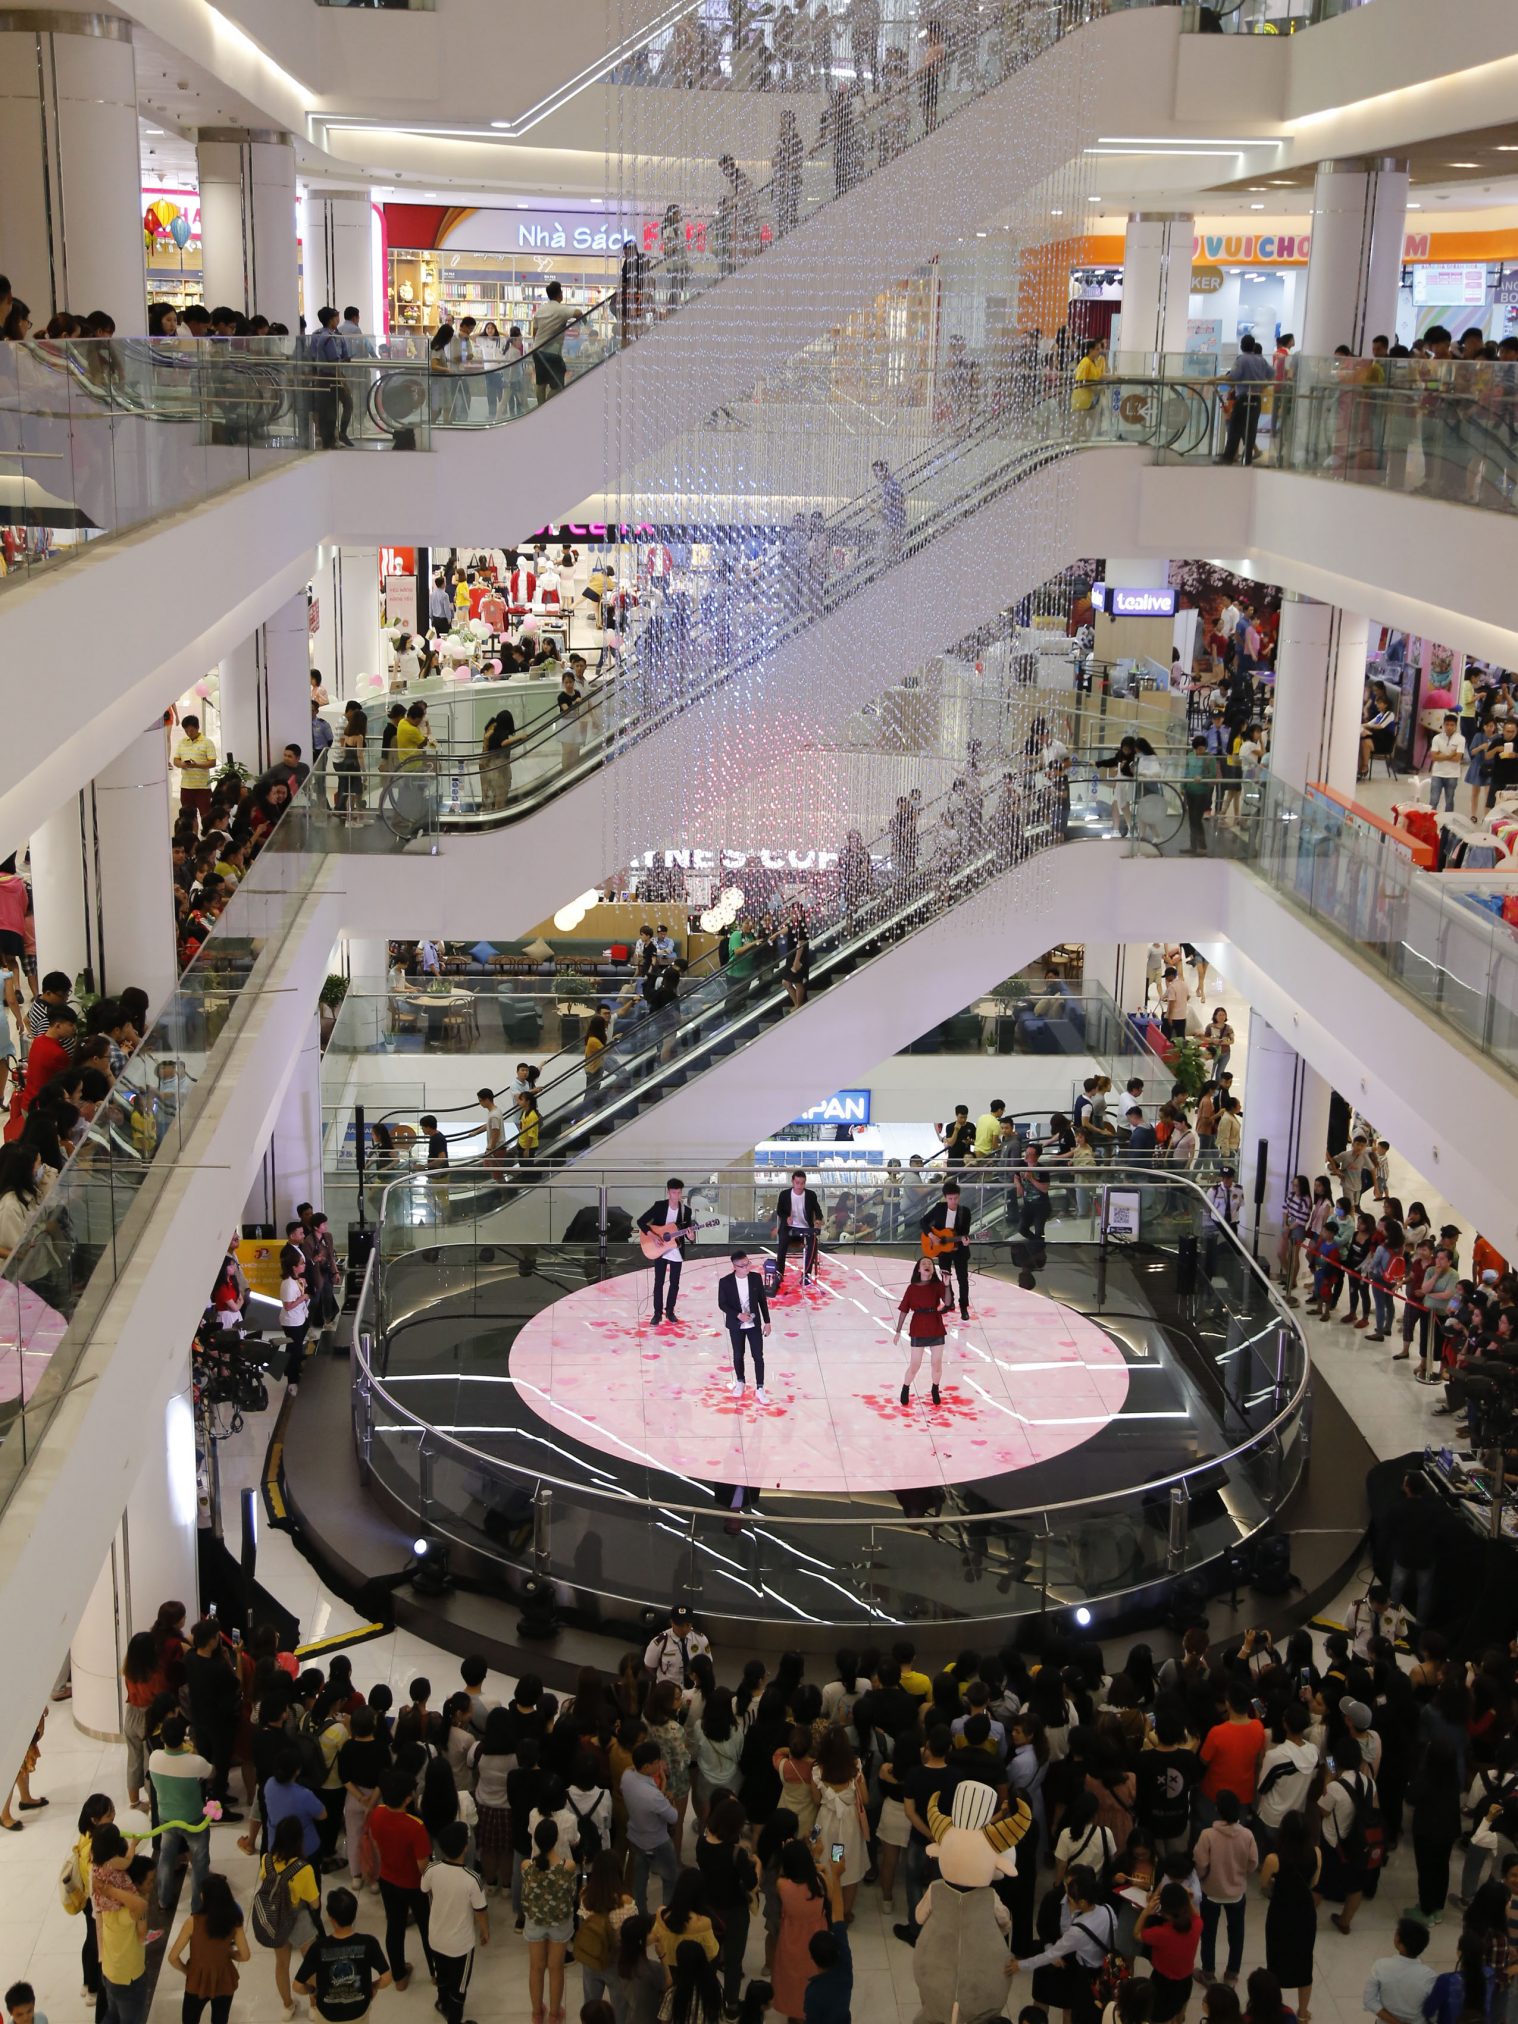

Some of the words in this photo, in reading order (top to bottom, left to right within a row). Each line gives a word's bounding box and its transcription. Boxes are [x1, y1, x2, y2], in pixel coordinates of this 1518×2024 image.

[518, 222, 566, 249] Nhà
[572, 223, 637, 251] Sách
[1206, 235, 1254, 259] VUI
[1116, 592, 1172, 611] tealive
